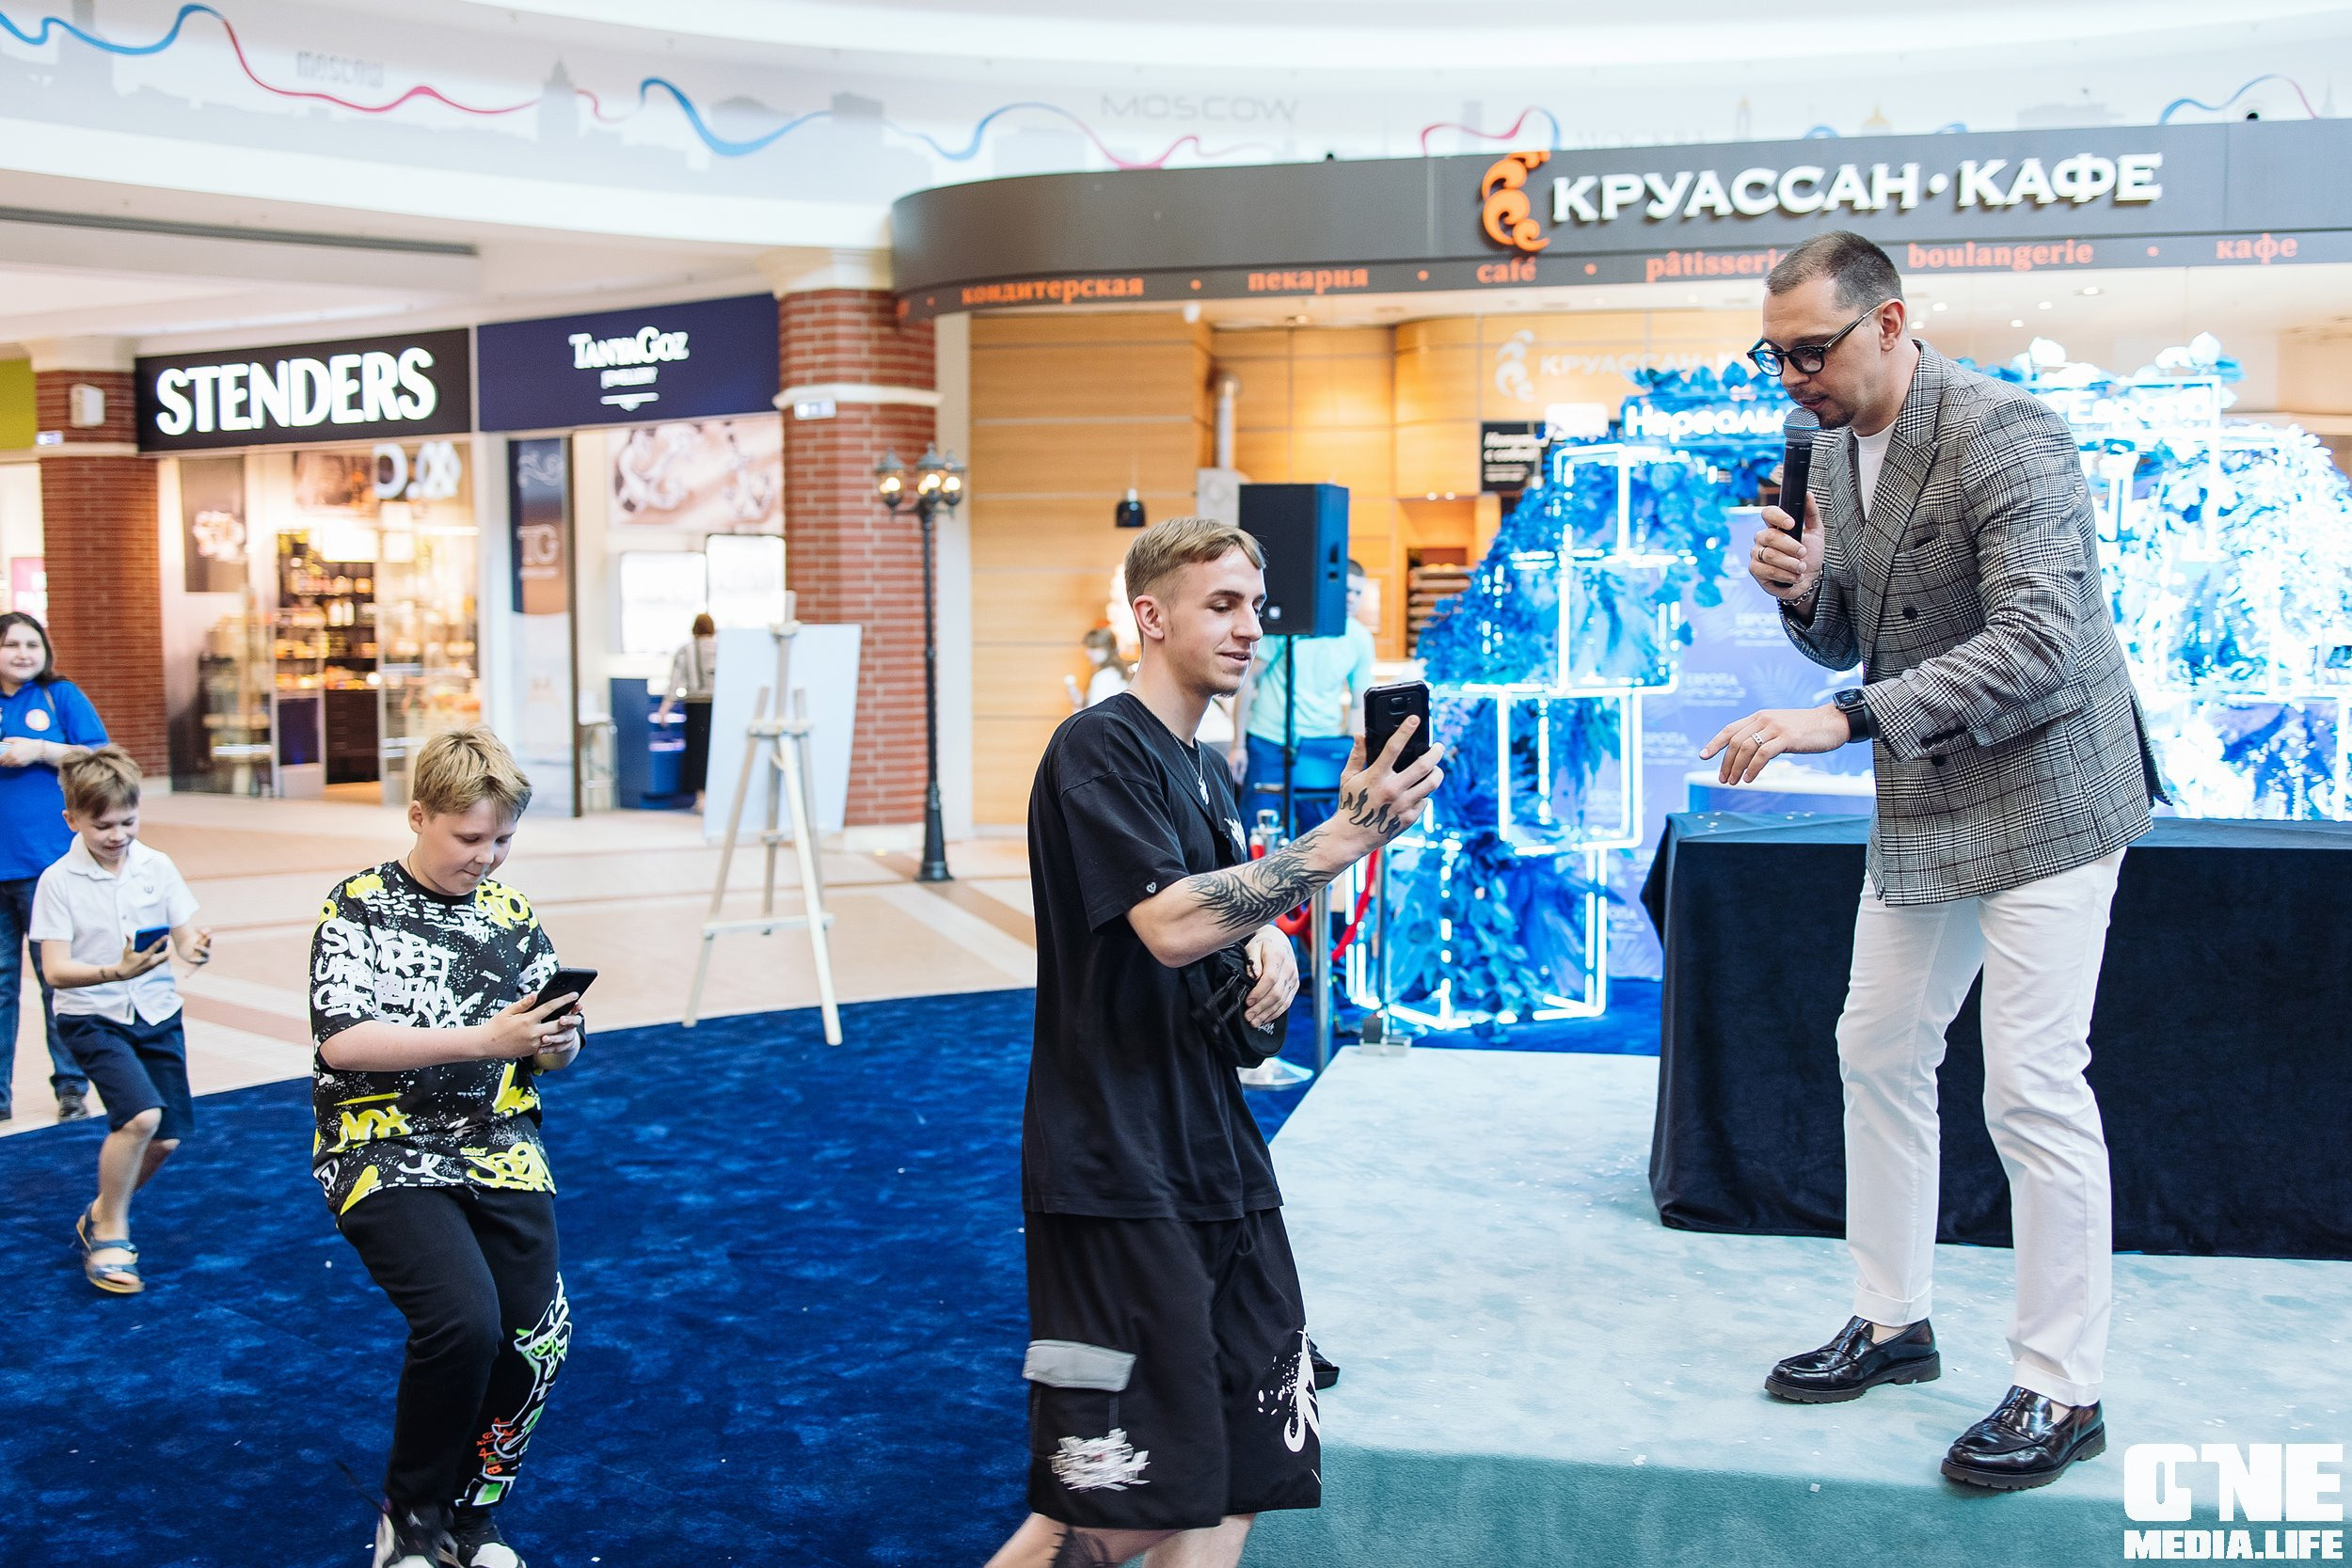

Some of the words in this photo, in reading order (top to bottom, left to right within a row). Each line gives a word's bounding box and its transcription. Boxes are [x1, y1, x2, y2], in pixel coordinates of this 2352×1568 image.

[1100, 95, 1300, 122] MOSCOW
[1552, 162, 1919, 222] КРУАССАН
[1958, 152, 2163, 207] КАФЕ
[1908, 238, 2094, 272] boulangerie
[2216, 232, 2298, 265] кафе
[1248, 267, 1369, 295] пекарня
[156, 346, 437, 436] STENDERS
